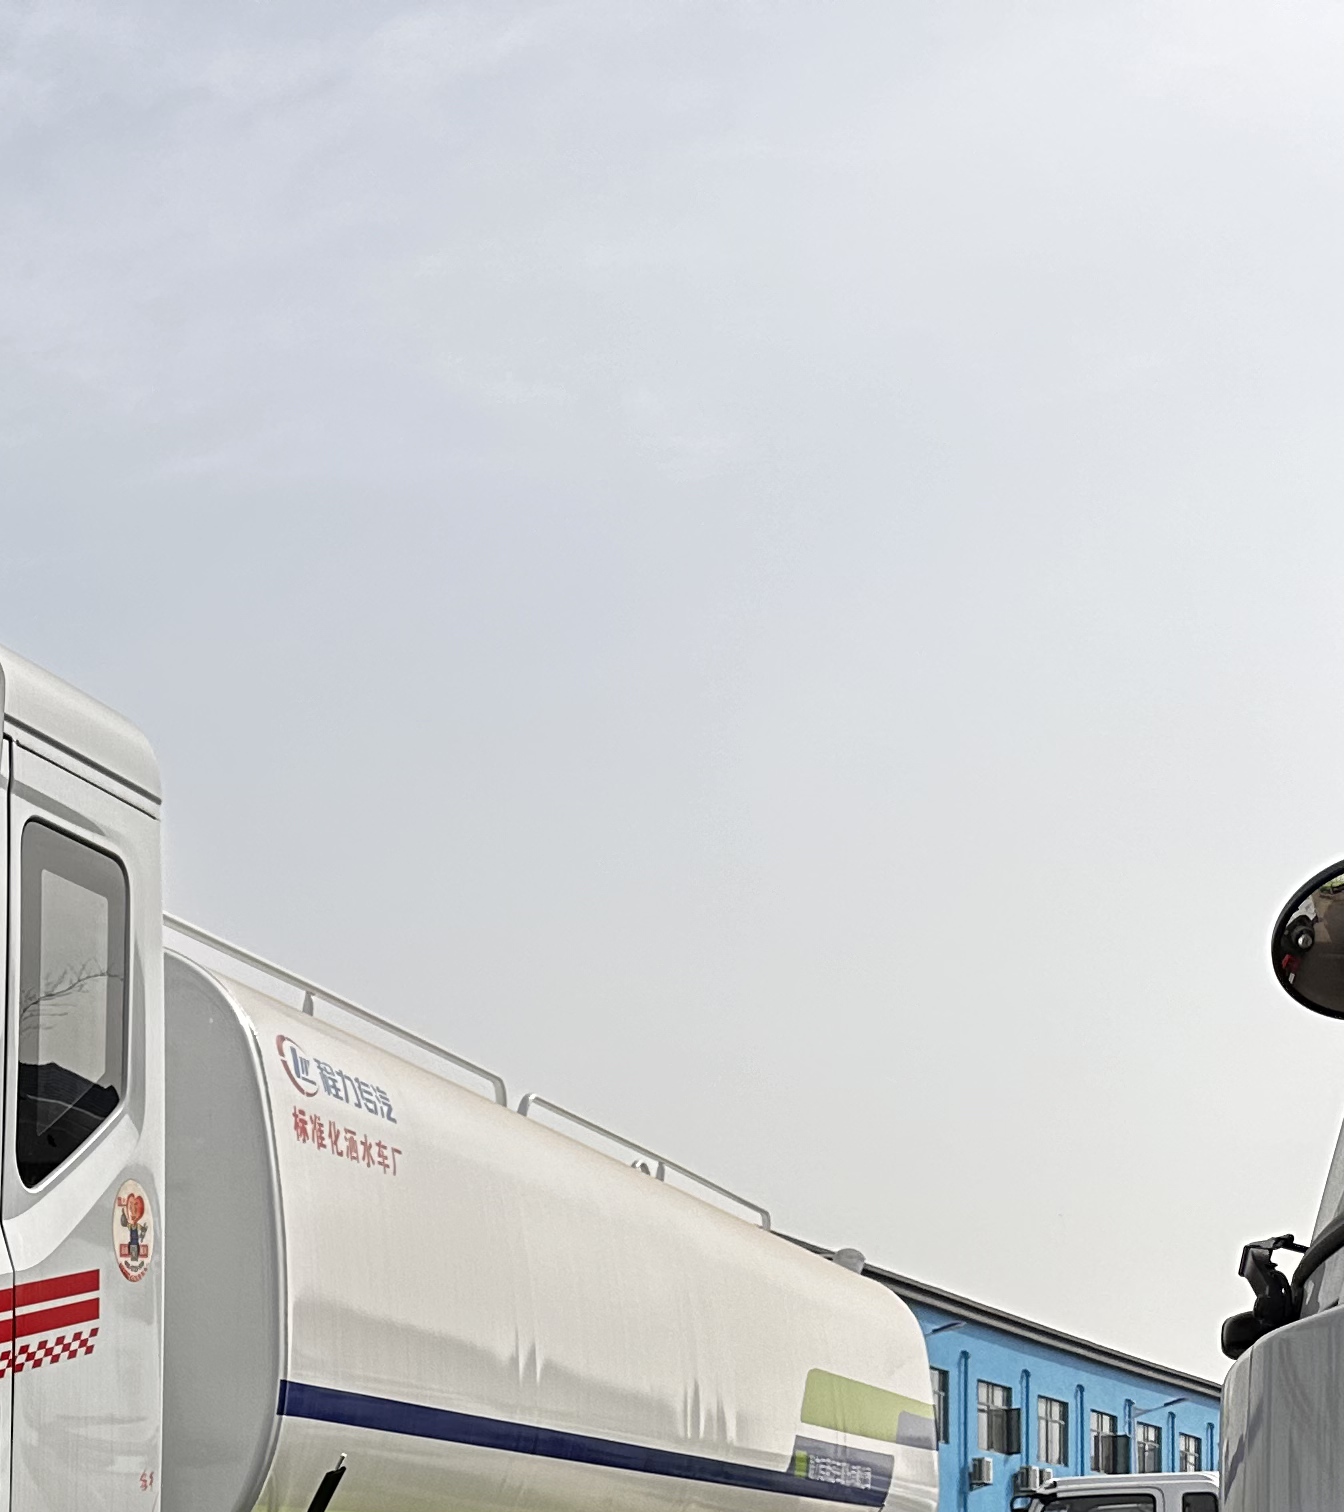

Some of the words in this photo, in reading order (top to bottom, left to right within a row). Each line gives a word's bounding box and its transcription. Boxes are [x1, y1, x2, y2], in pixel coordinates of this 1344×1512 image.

[292, 1105, 403, 1176] 标准化洒水车厂
